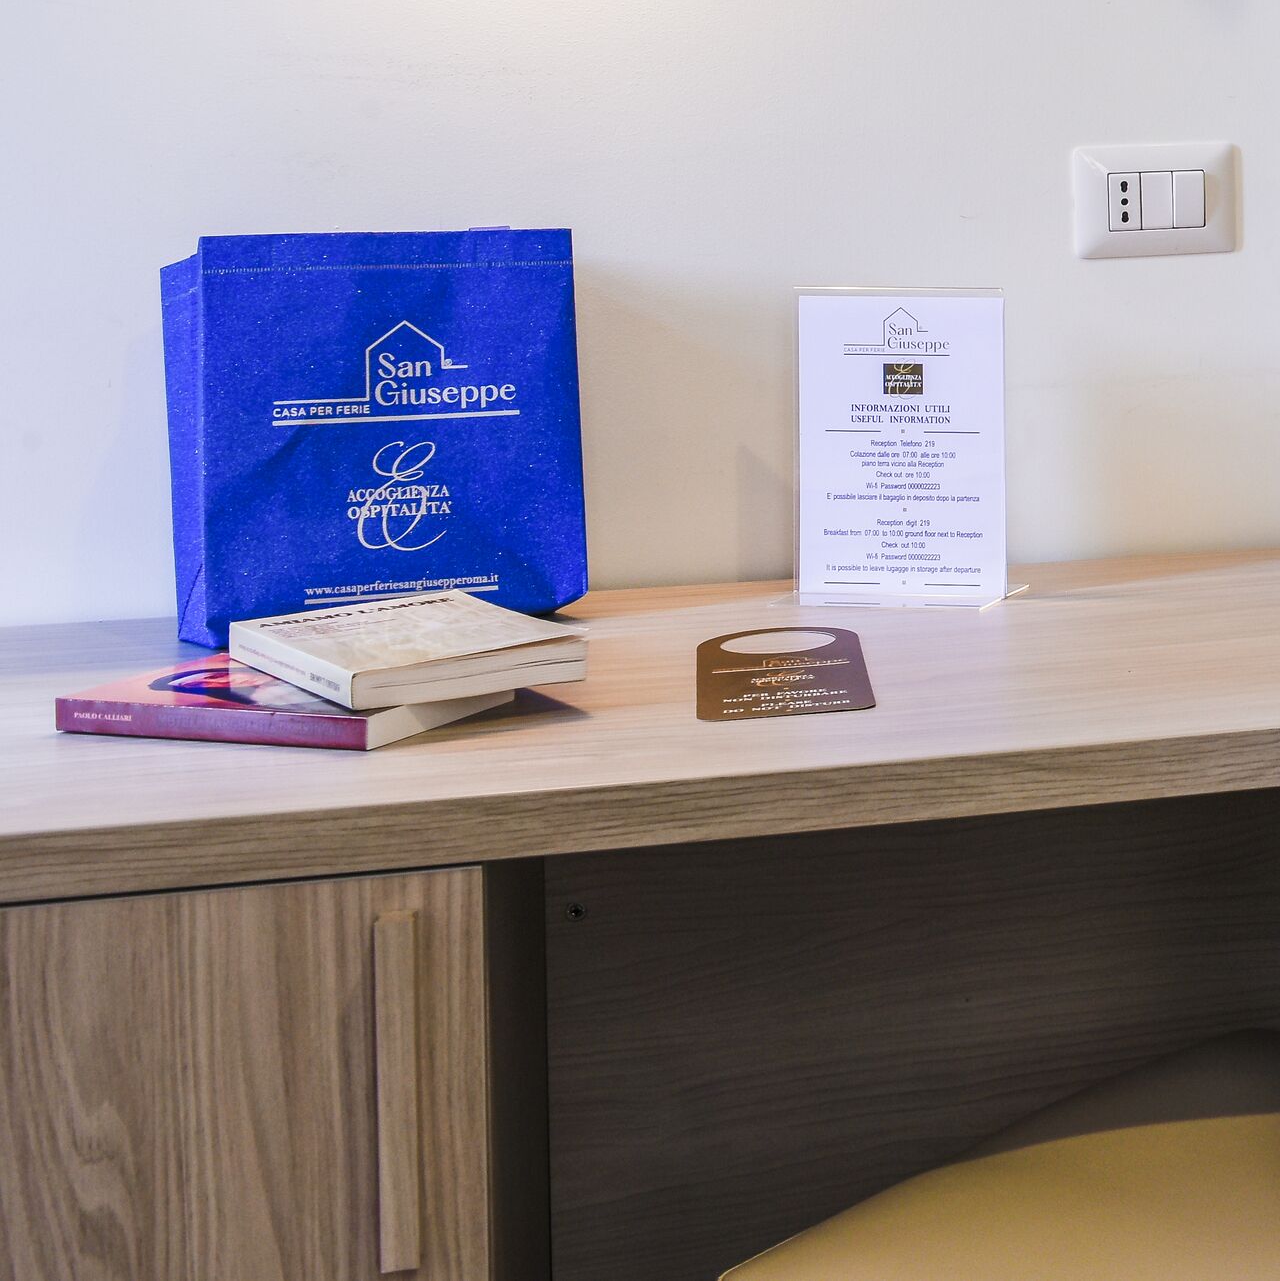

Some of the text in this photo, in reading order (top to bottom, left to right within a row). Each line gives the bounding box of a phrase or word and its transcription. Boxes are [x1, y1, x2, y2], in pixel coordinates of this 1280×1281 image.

[888, 322, 913, 336] San
[887, 336, 950, 353] Giuseppe
[377, 352, 432, 379] San
[374, 379, 516, 409] Giuseppe
[273, 405, 371, 418] CASA PER FERIE
[851, 404, 950, 413] INFORMAZIONI UTILI
[851, 415, 951, 424] USEFUL INFORMATION
[871, 440, 936, 448] Reception Telefono 219
[347, 485, 450, 503] ACCOGLIENZA
[833, 493, 856, 501] possibile
[883, 493, 905, 502] bagaglio
[877, 519, 904, 527] Reception
[906, 519, 917, 527] digit
[905, 530, 923, 538] ground
[957, 531, 983, 539] Reception
[881, 553, 907, 561] Password
[838, 564, 861, 572] possible
[917, 566, 938, 574] storage
[954, 566, 981, 574] departure
[304, 573, 499, 596] www.casaperferiesangiusepperoma.it
[259, 597, 454, 629] AMIAMO L'AMORE
